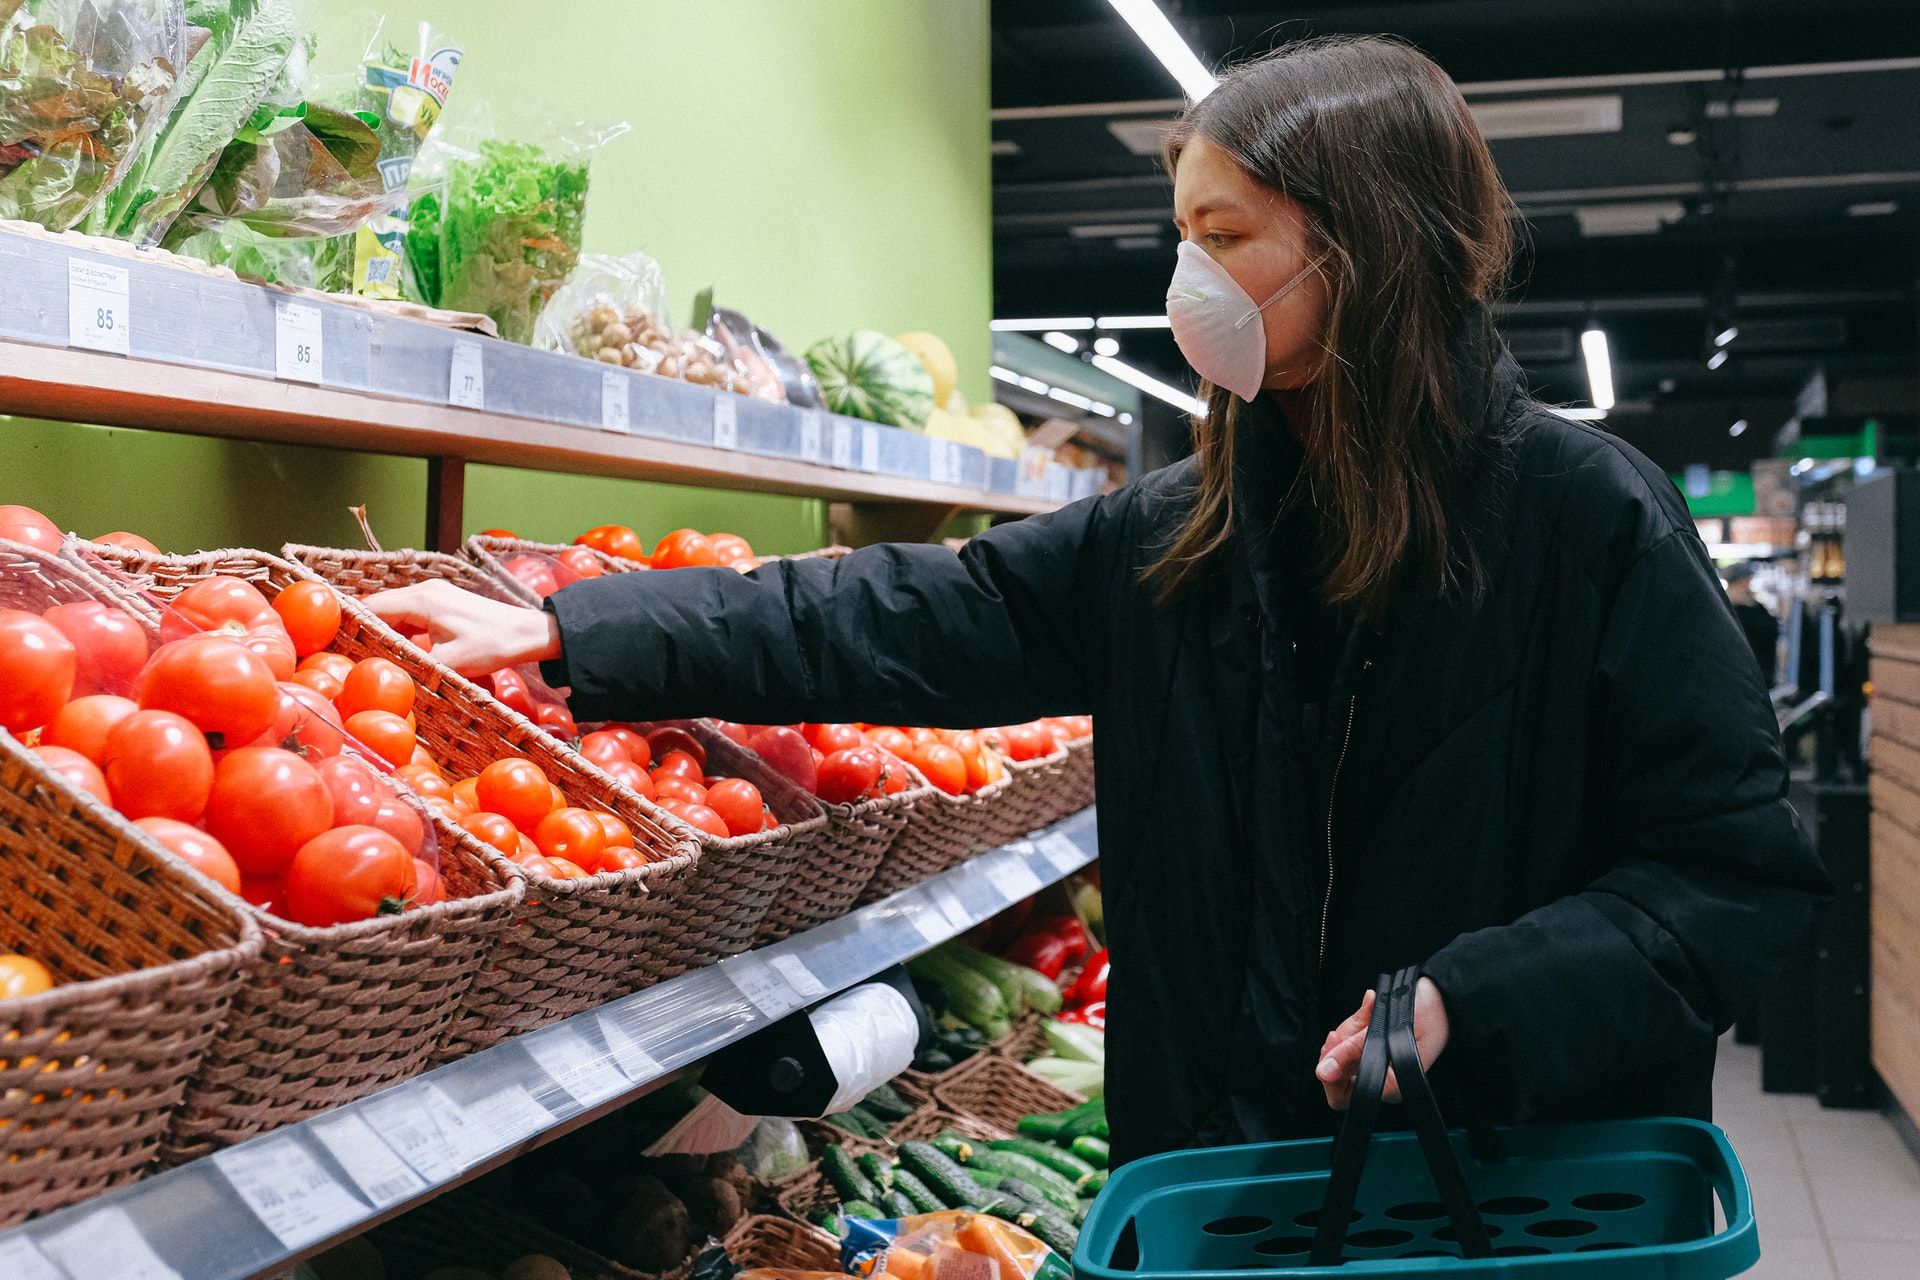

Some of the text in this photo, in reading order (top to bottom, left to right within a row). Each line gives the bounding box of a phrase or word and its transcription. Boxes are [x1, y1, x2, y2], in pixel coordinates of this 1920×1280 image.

[97, 308, 113, 329] 85
[297, 344, 310, 363] 85
[464, 375, 474, 392] 77
